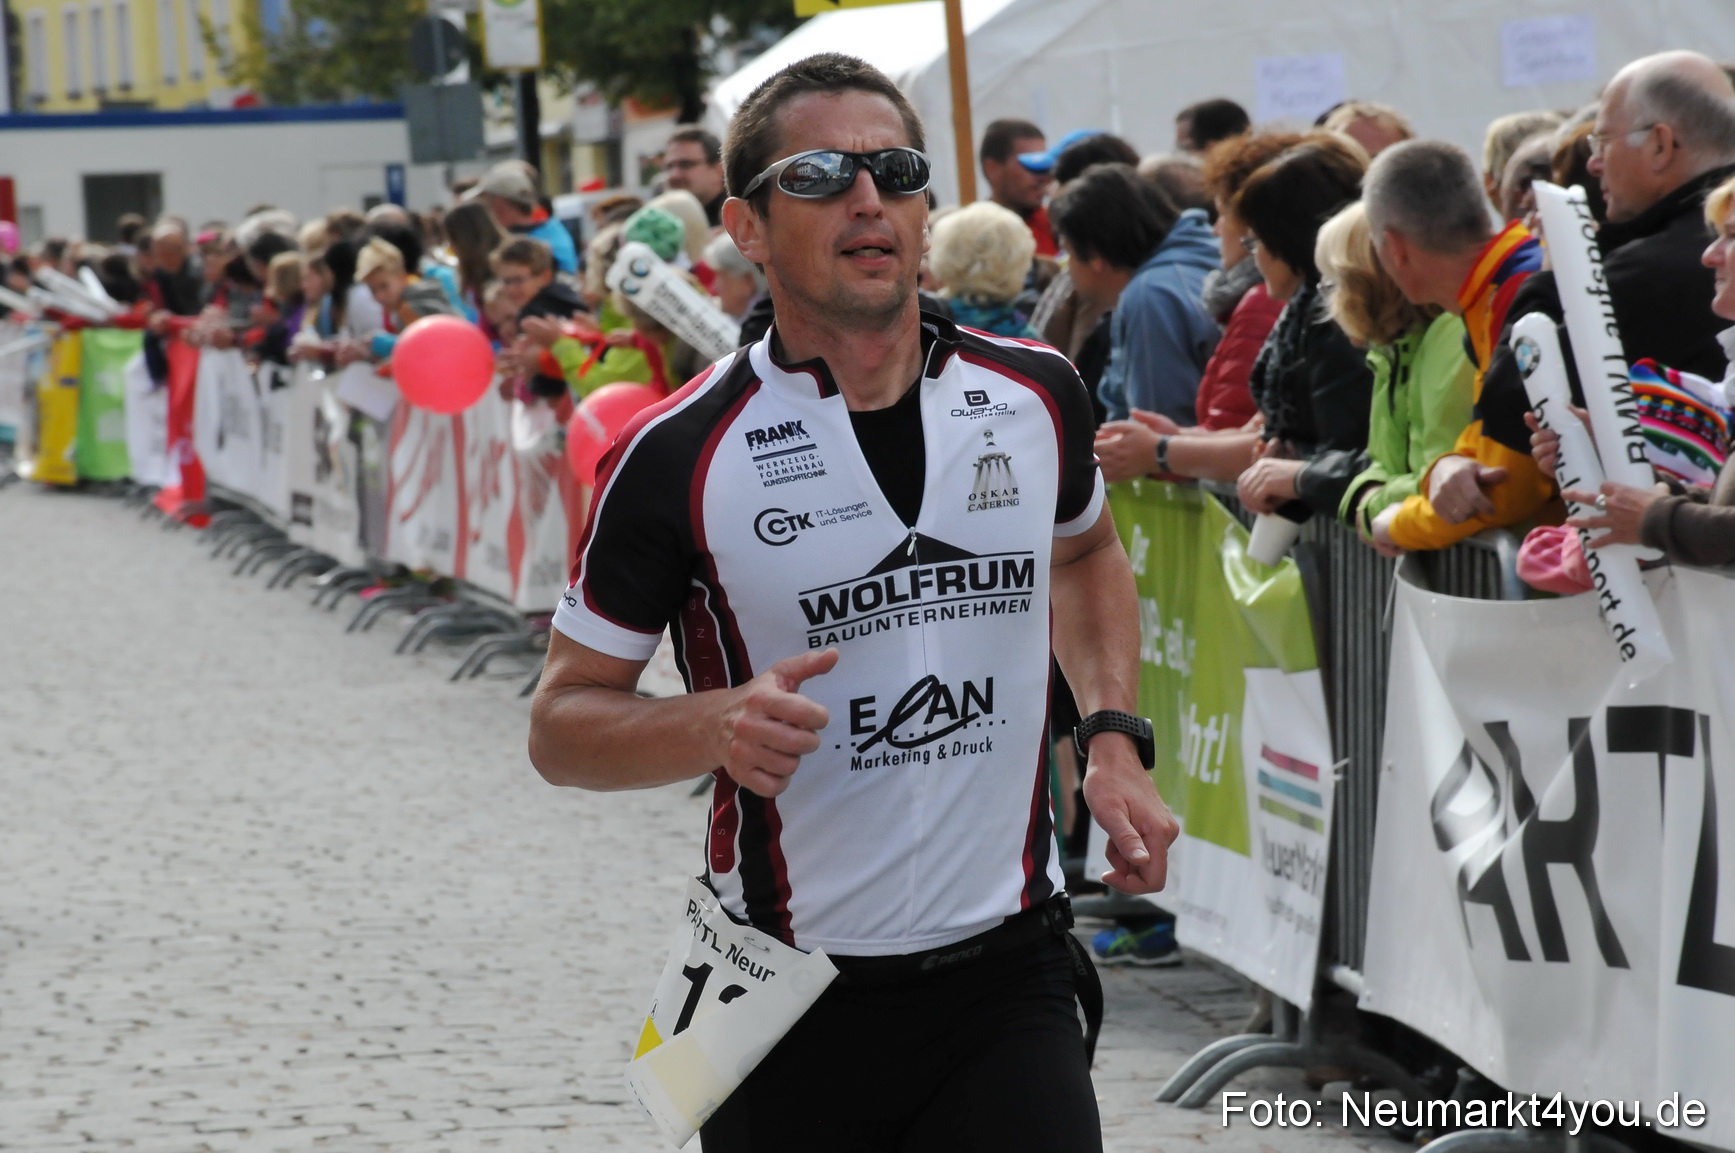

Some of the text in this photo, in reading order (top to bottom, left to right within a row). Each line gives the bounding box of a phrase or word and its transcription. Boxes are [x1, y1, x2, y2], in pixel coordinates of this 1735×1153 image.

[745, 420, 808, 448] FRANK
[756, 453, 820, 471] WERKZEUG-
[759, 460, 824, 479] FORMENBAU
[763, 469, 828, 488] KUNSTSTOFFTECHNIK
[968, 487, 1019, 501] OSKAR
[815, 501, 869, 518] IT-Lösungen
[967, 498, 1020, 513] CATERING
[820, 508, 873, 526] und Service
[798, 557, 1035, 626] WOLFRUM
[808, 599, 1031, 649] BAUUNTERNEHMEN
[850, 736, 993, 771] Marketing & Druck
